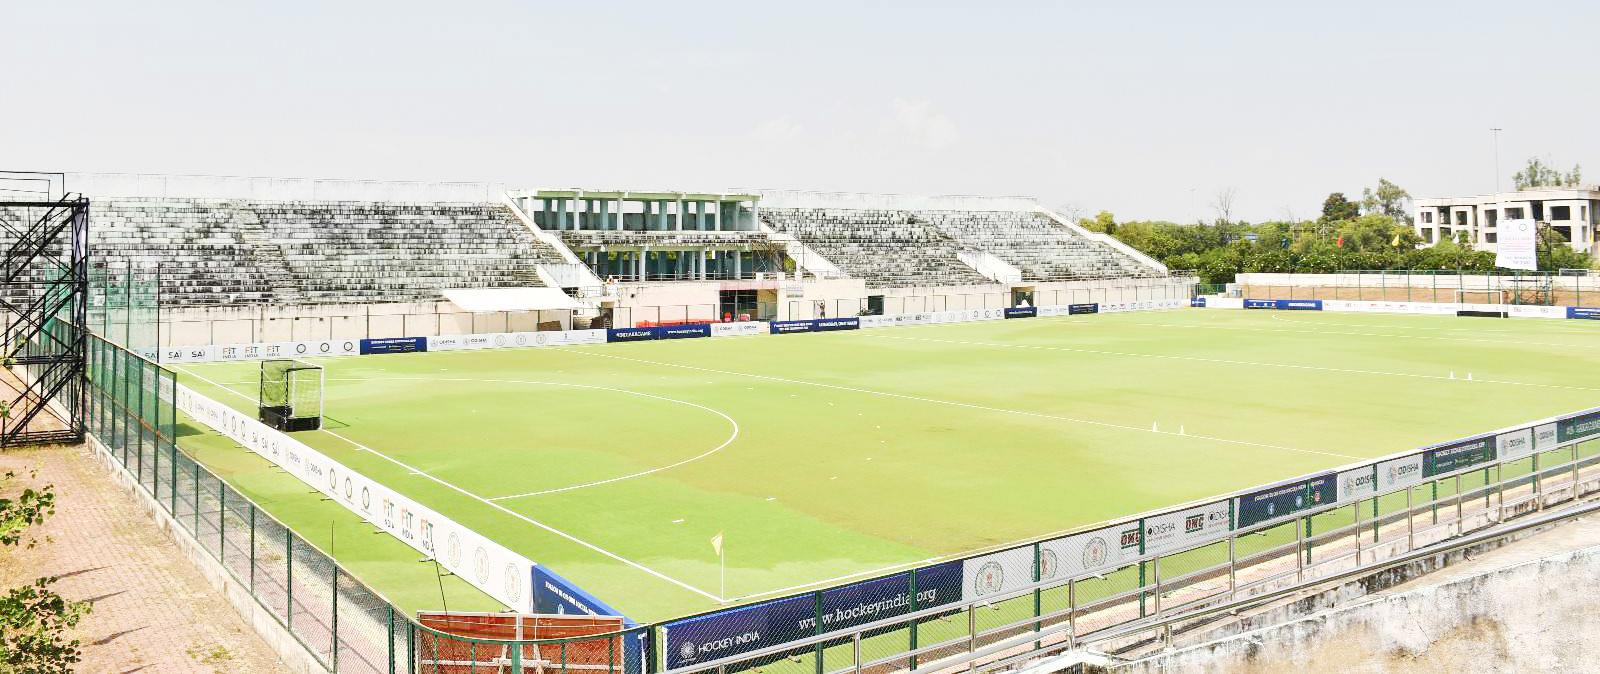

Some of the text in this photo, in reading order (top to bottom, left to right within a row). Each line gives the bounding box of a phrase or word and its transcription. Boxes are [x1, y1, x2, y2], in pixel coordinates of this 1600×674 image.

[1355, 473, 1375, 486] ODISH
[1398, 463, 1418, 475] ODISHA
[383, 498, 395, 518] FIT
[402, 508, 413, 529] FIT
[421, 518, 433, 541] FIT
[799, 588, 937, 630] www.hockeyindiaorg
[698, 630, 761, 654] HOCKEY INDIA
